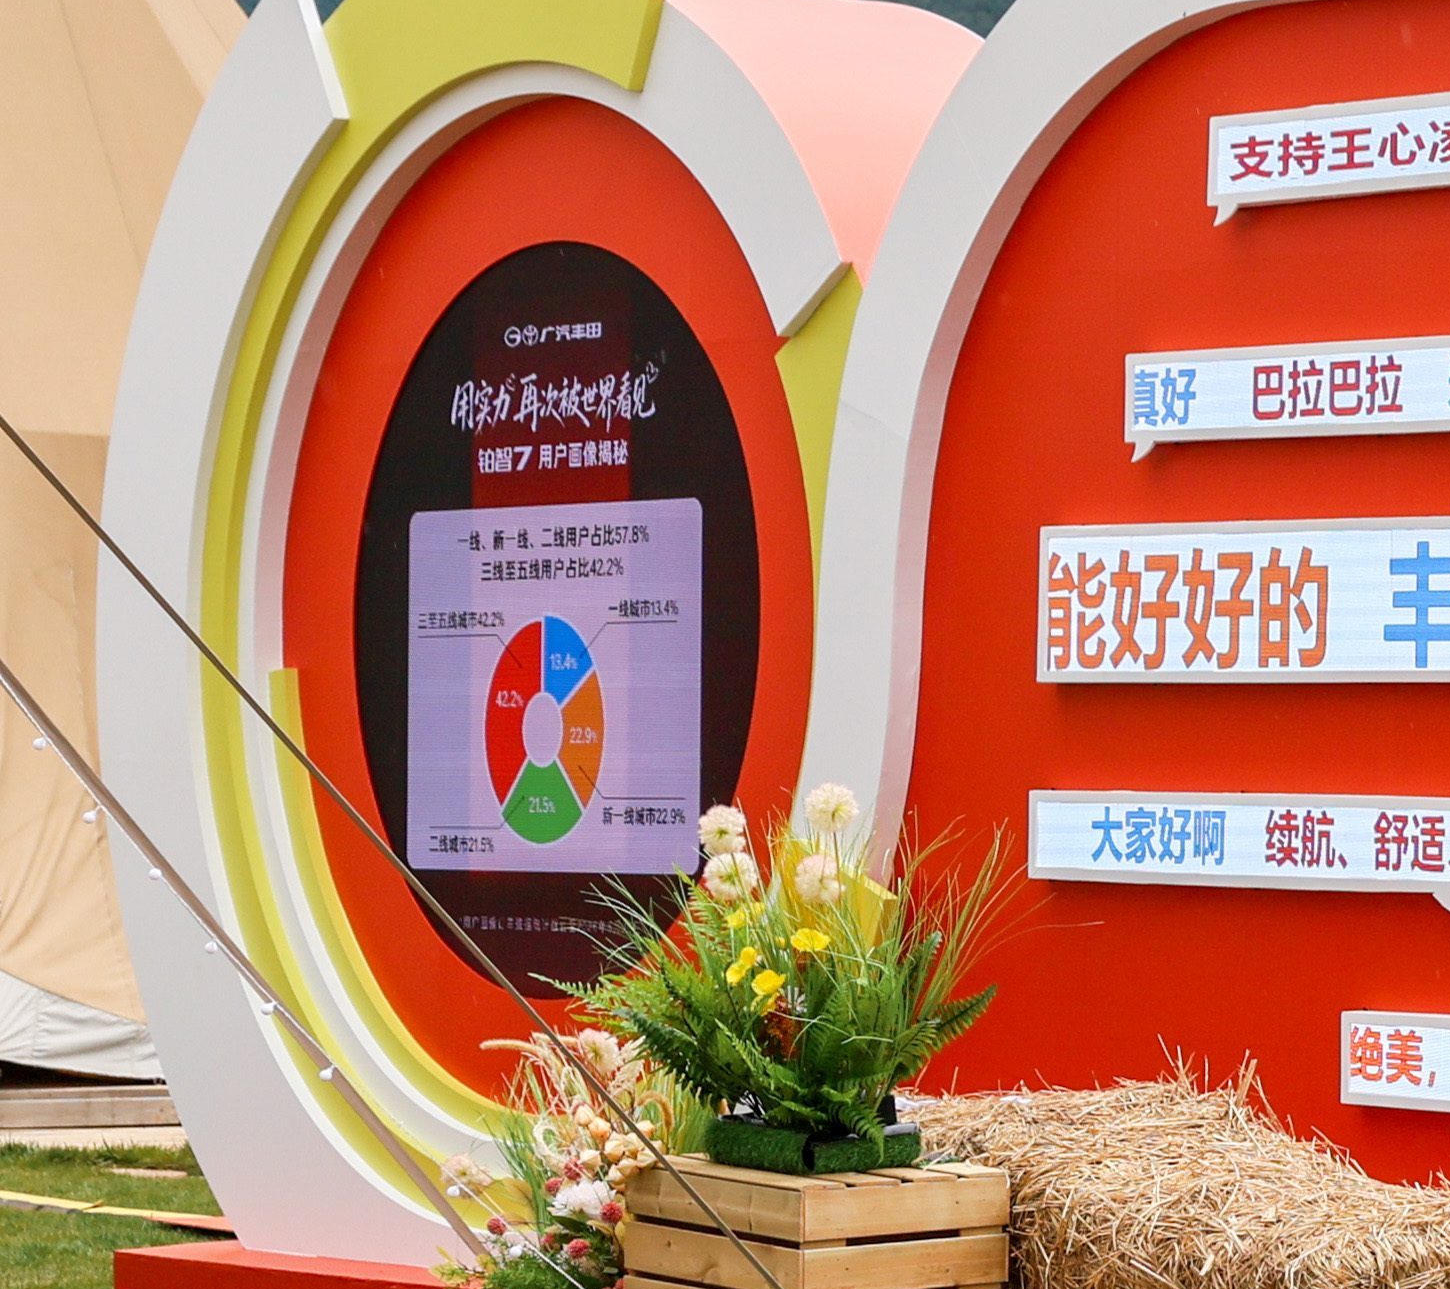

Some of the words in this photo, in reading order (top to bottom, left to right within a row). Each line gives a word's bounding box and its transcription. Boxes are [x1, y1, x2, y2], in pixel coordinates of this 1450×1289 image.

[539, 322, 602, 342] 广汽丰田
[1134, 368, 1197, 426] 真好
[1252, 356, 1404, 421] 巴拉巴拉
[1048, 545, 1329, 671] 能好好的
[1090, 805, 1226, 867] 大家好啊
